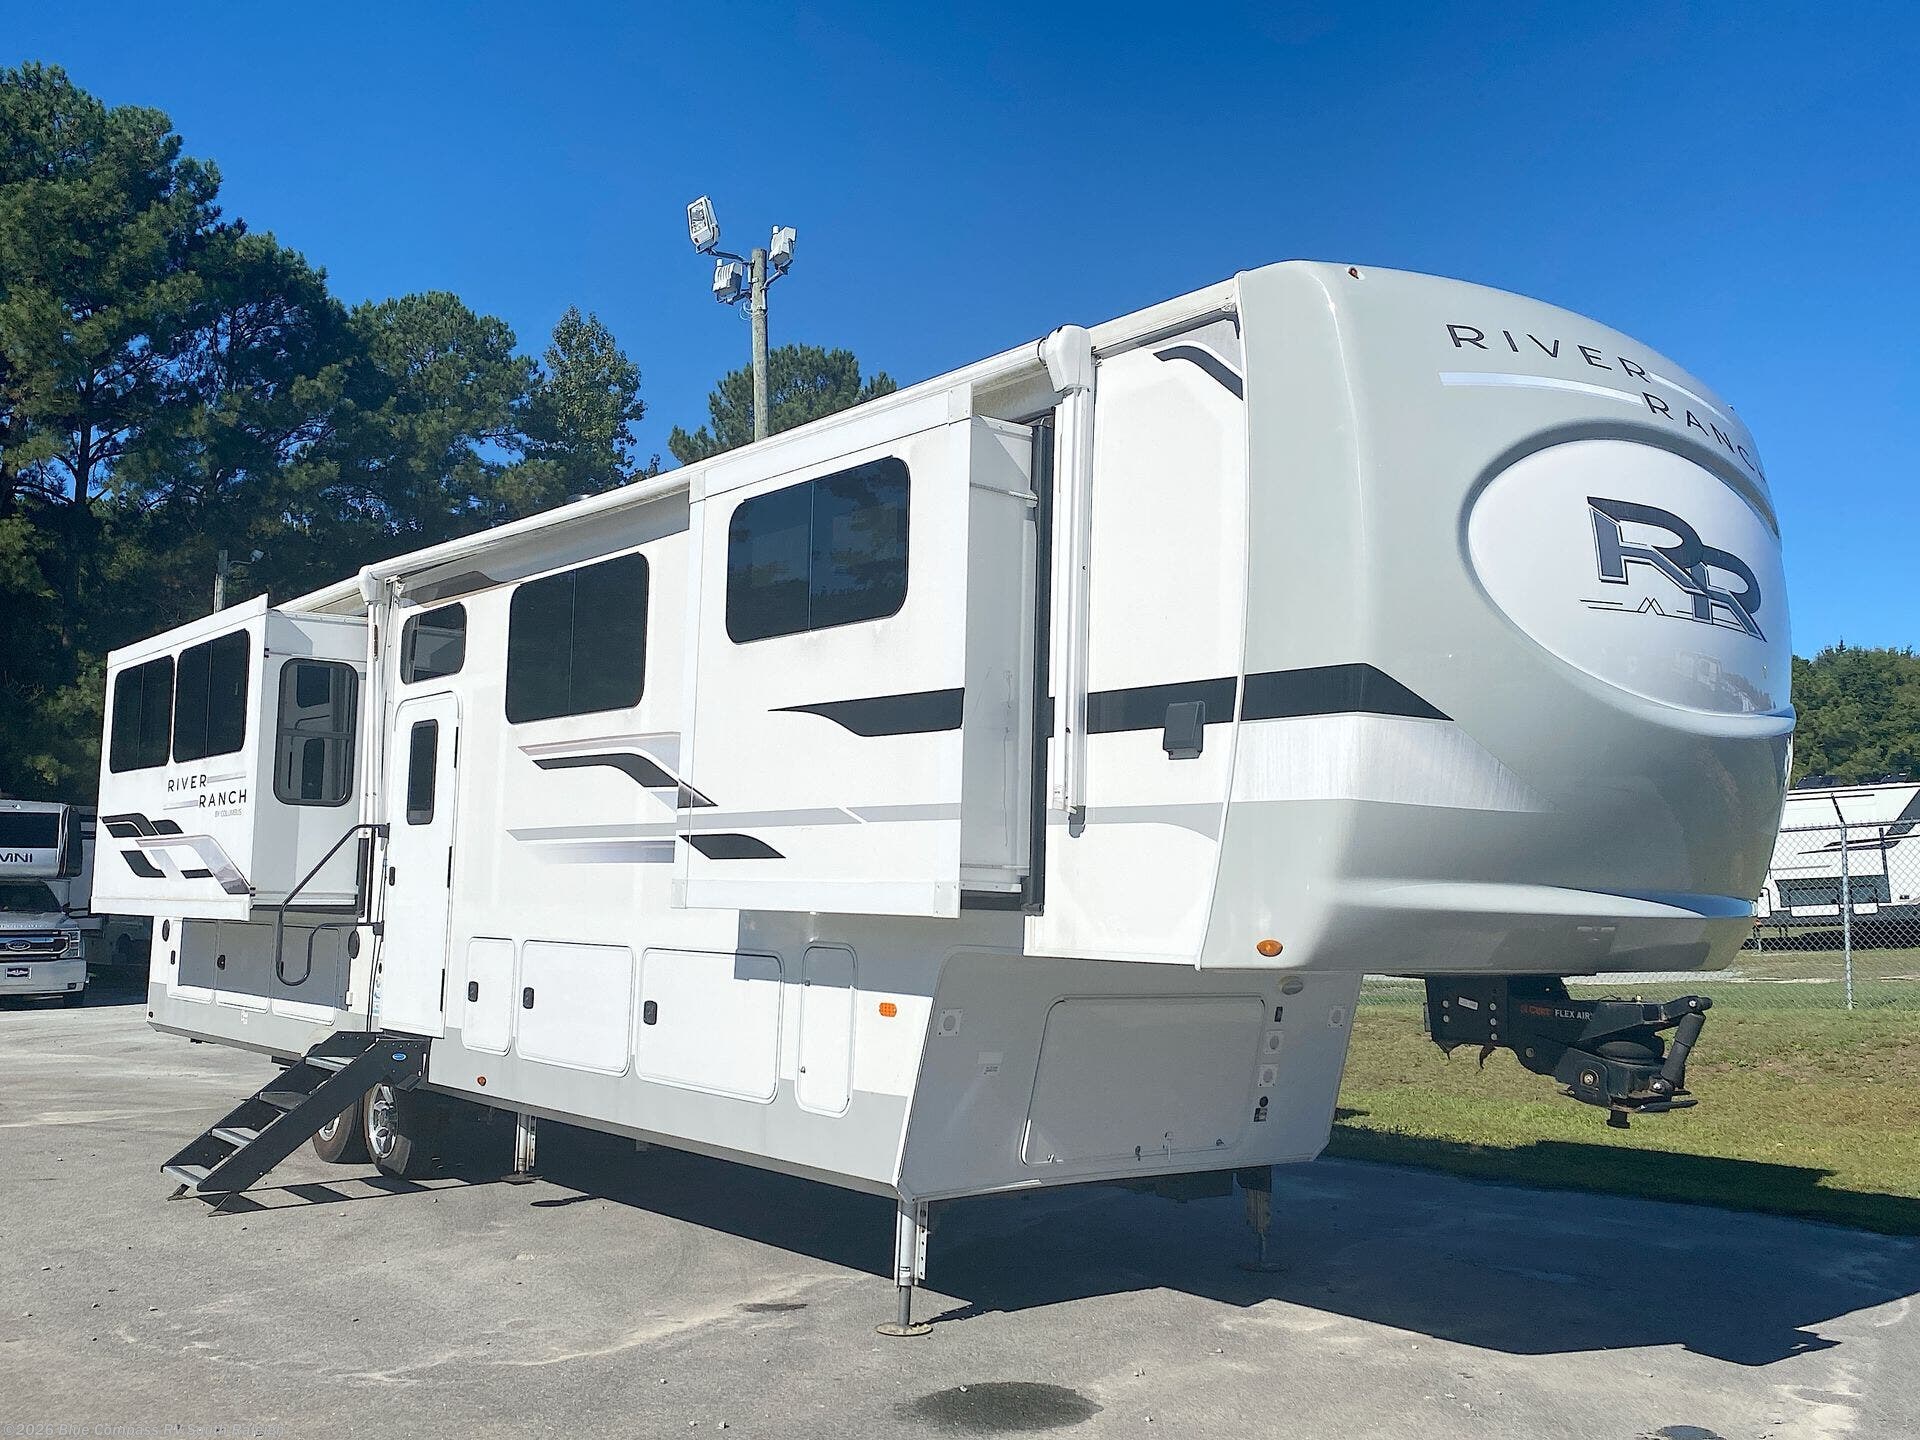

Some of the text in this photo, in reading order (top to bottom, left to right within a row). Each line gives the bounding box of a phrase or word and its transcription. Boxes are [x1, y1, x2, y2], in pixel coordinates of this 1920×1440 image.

[1446, 323, 1651, 384] RIVER
[167, 774, 207, 793] RIVER
[198, 788, 247, 809] RANCH
[1554, 1008, 1576, 1019] FLEX
[1576, 1011, 1591, 1021] AIR
